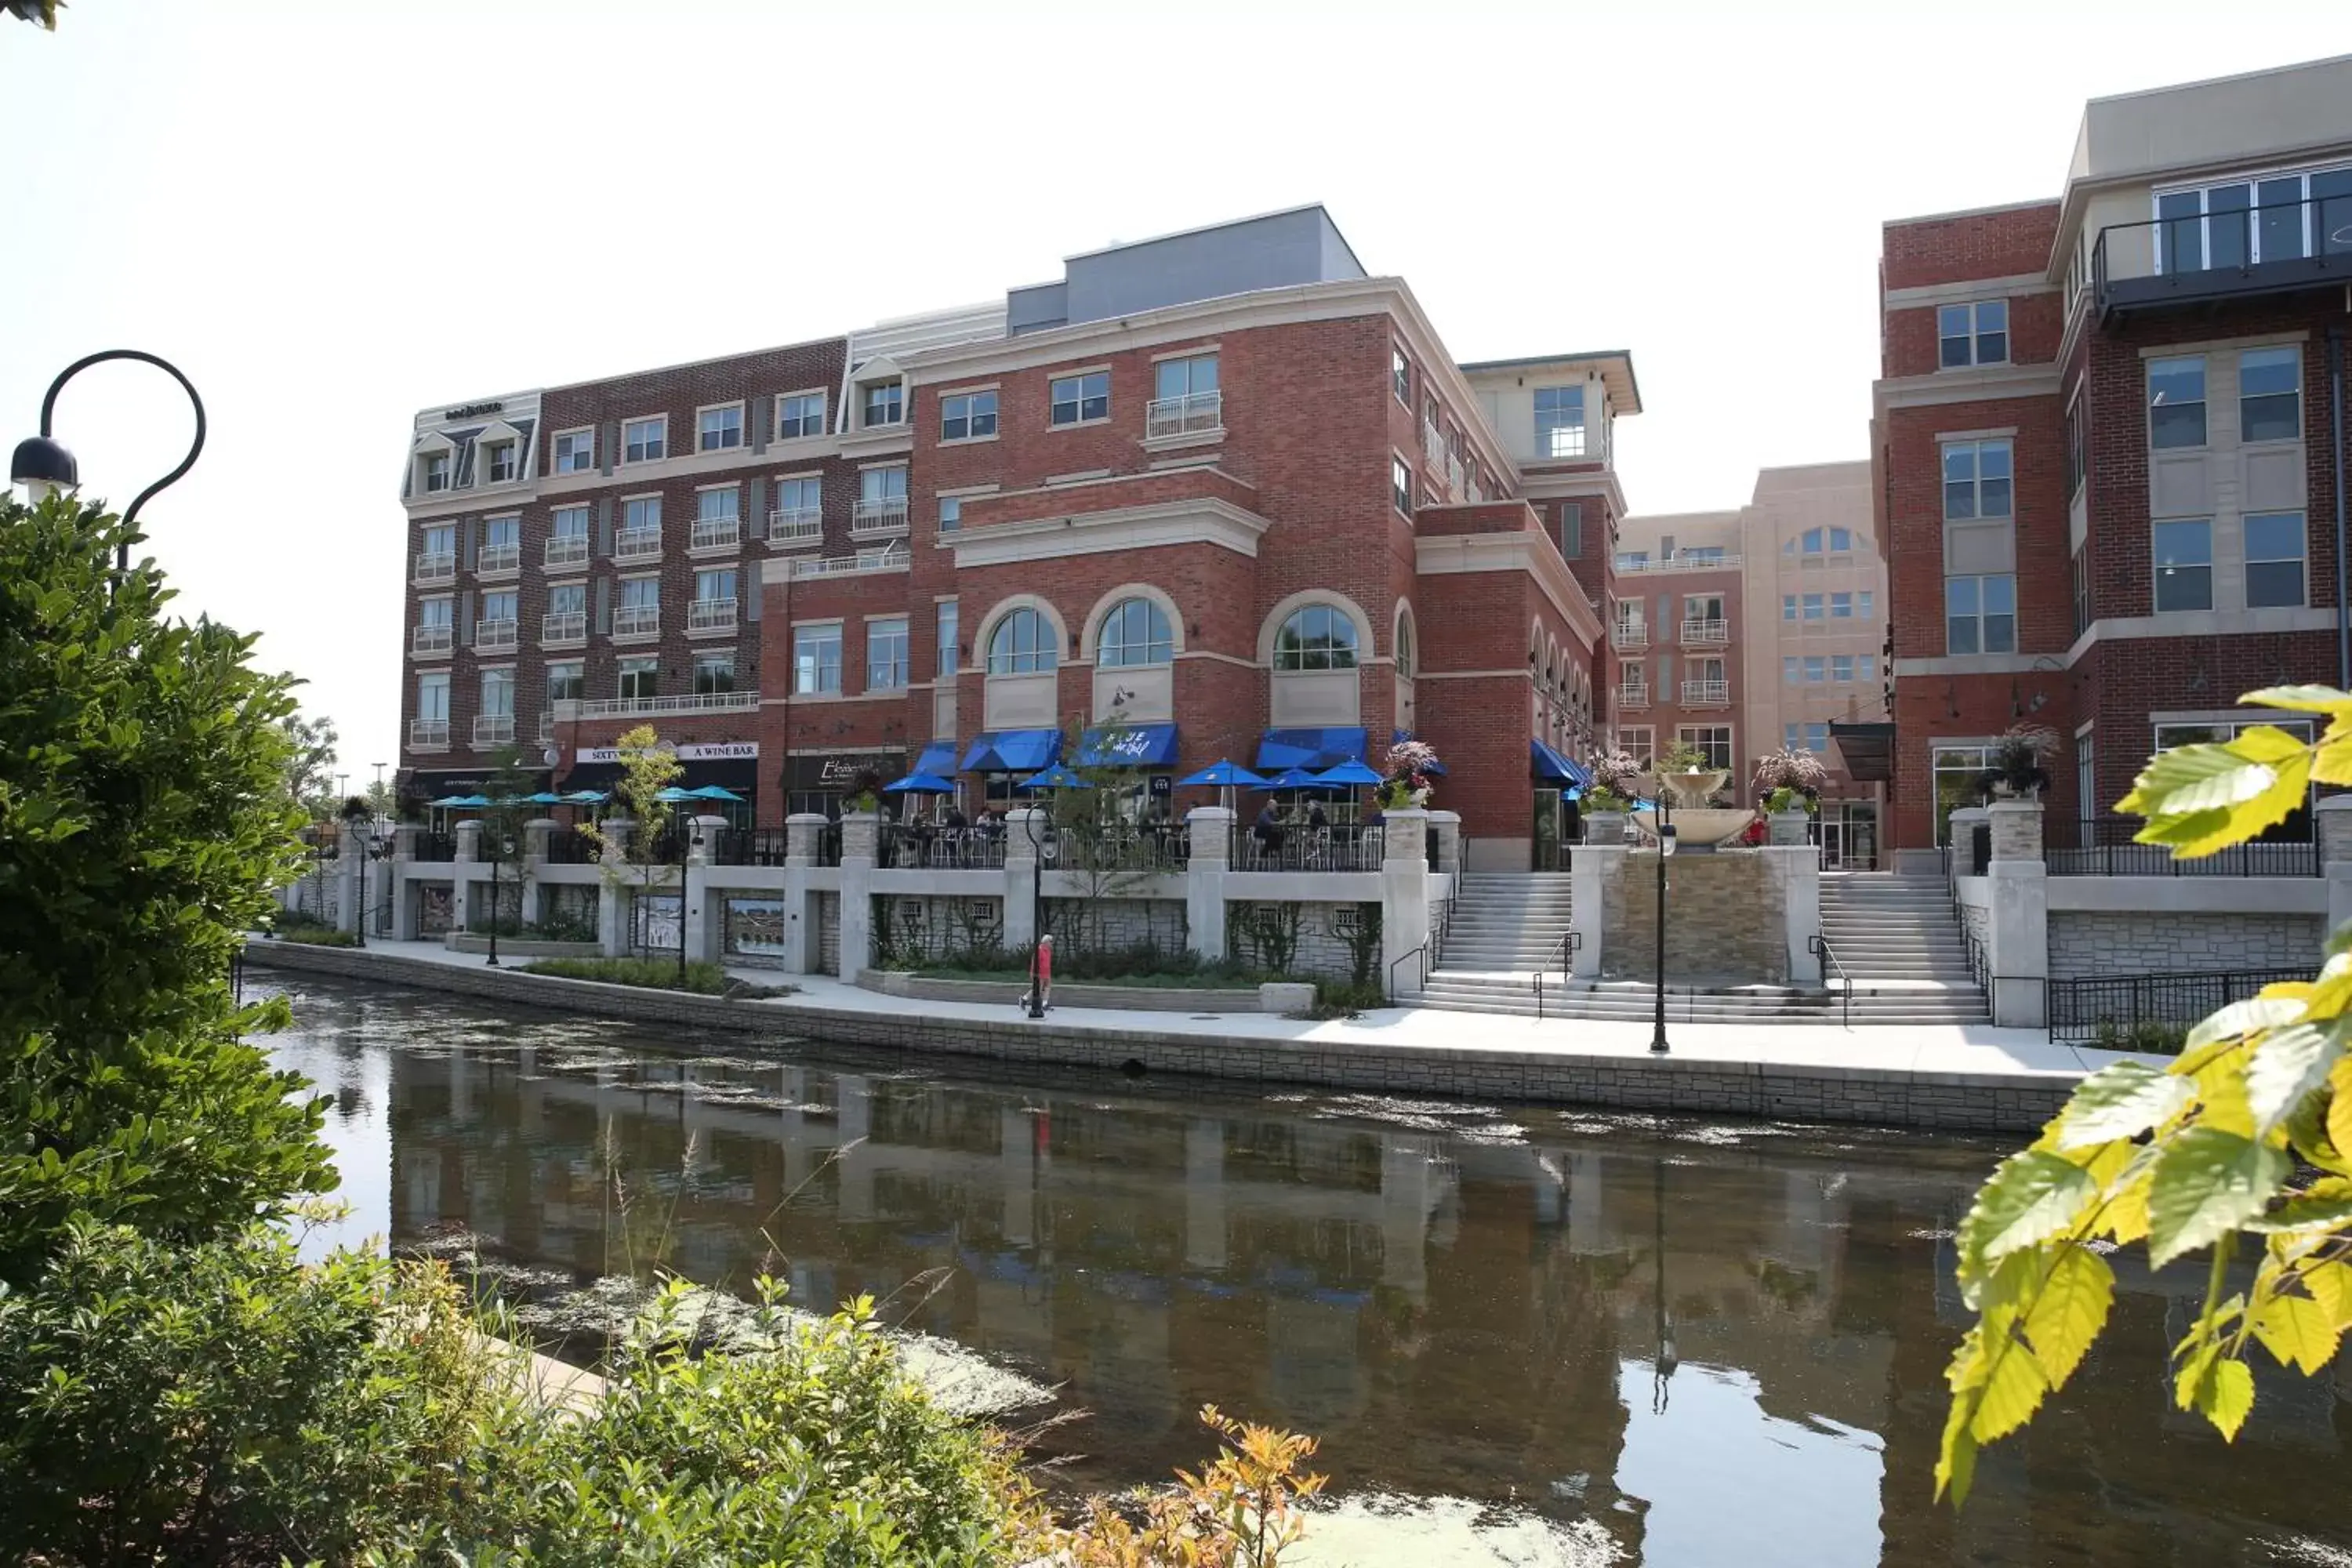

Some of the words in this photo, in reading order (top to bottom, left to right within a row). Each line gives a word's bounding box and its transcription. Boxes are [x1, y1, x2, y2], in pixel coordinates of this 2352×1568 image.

[694, 747, 702, 757] A
[704, 746, 731, 757] WINE
[733, 746, 754, 756] BAR
